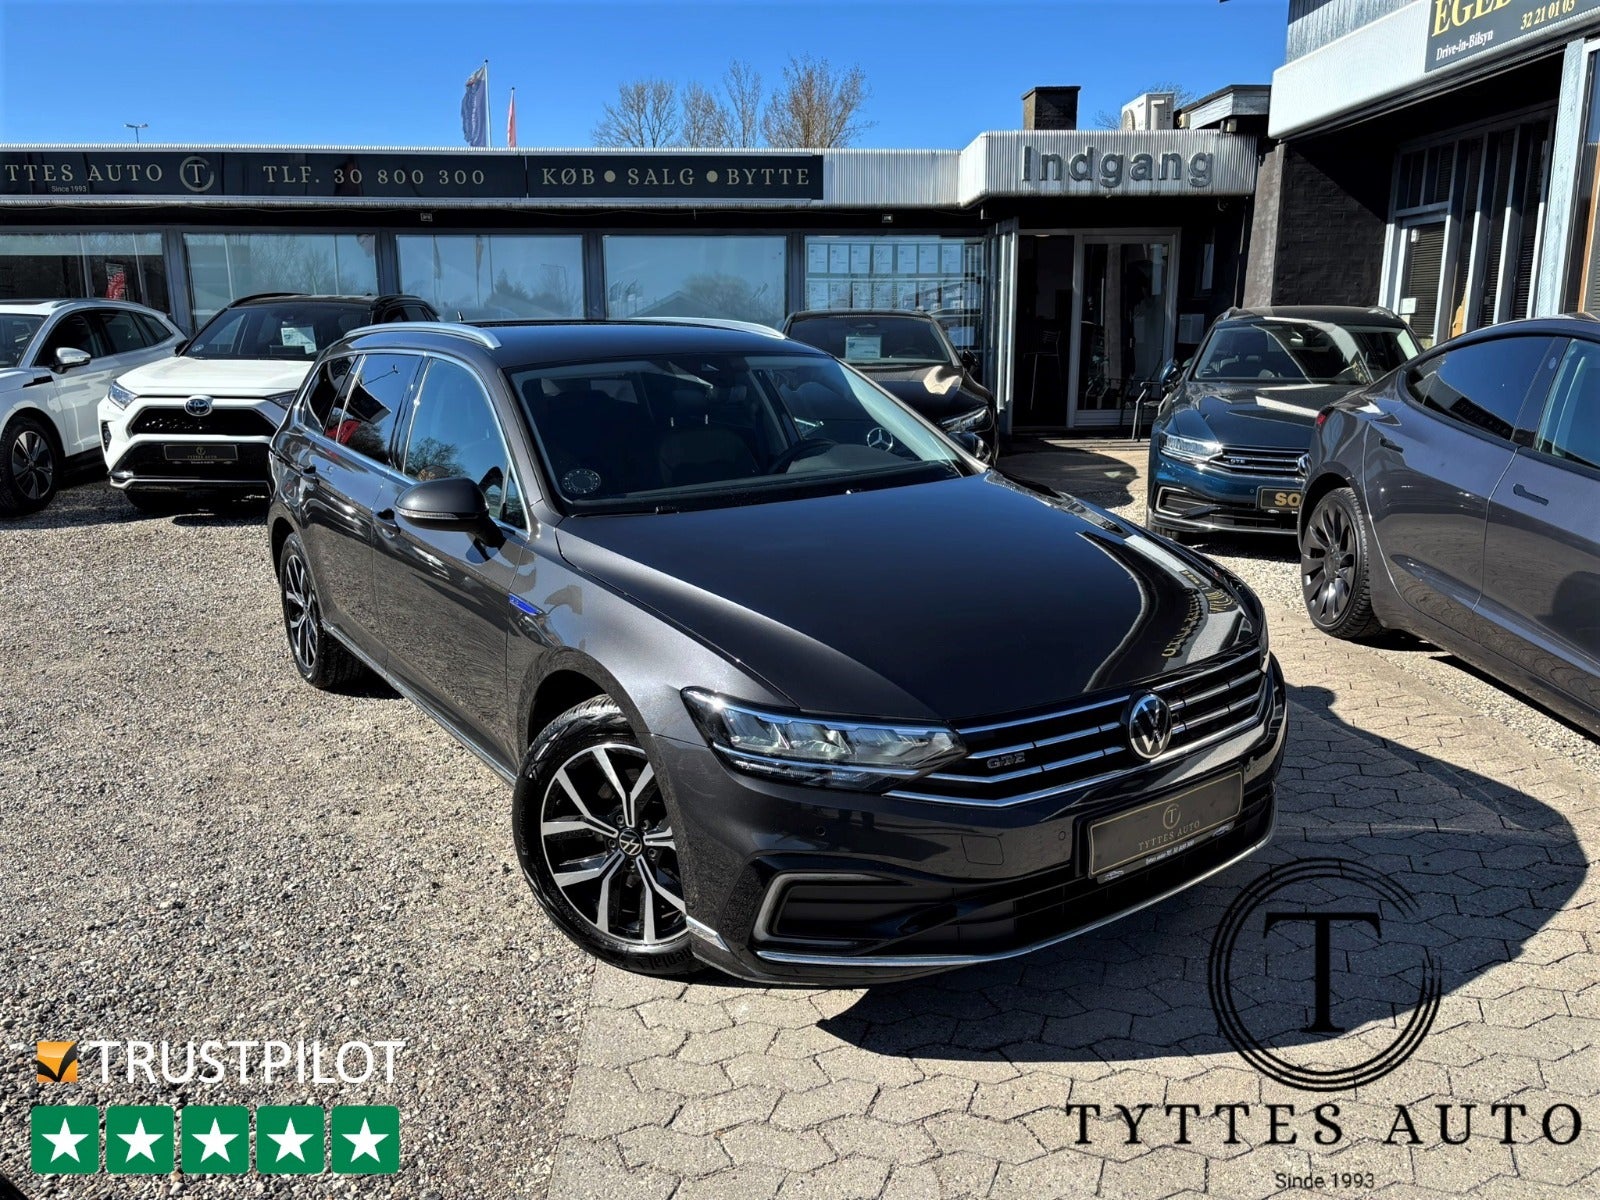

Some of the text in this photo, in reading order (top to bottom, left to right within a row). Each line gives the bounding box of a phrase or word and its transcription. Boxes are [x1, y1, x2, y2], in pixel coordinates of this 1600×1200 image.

[1520, 11, 1533, 30] 32
[1533, 5, 1546, 25] 21
[1547, 0, 1560, 19] 01
[4, 163, 163, 182] TTES AUTO
[263, 165, 485, 186] TLF. 30 800 300
[541, 167, 810, 186] KØB SALG BYTTE
[1022, 145, 1214, 188] Indgang
[51, 185, 87, 193] Since 1993
[986, 752, 1026, 769] GTE
[1138, 820, 1200, 851] TYTTES AUTO
